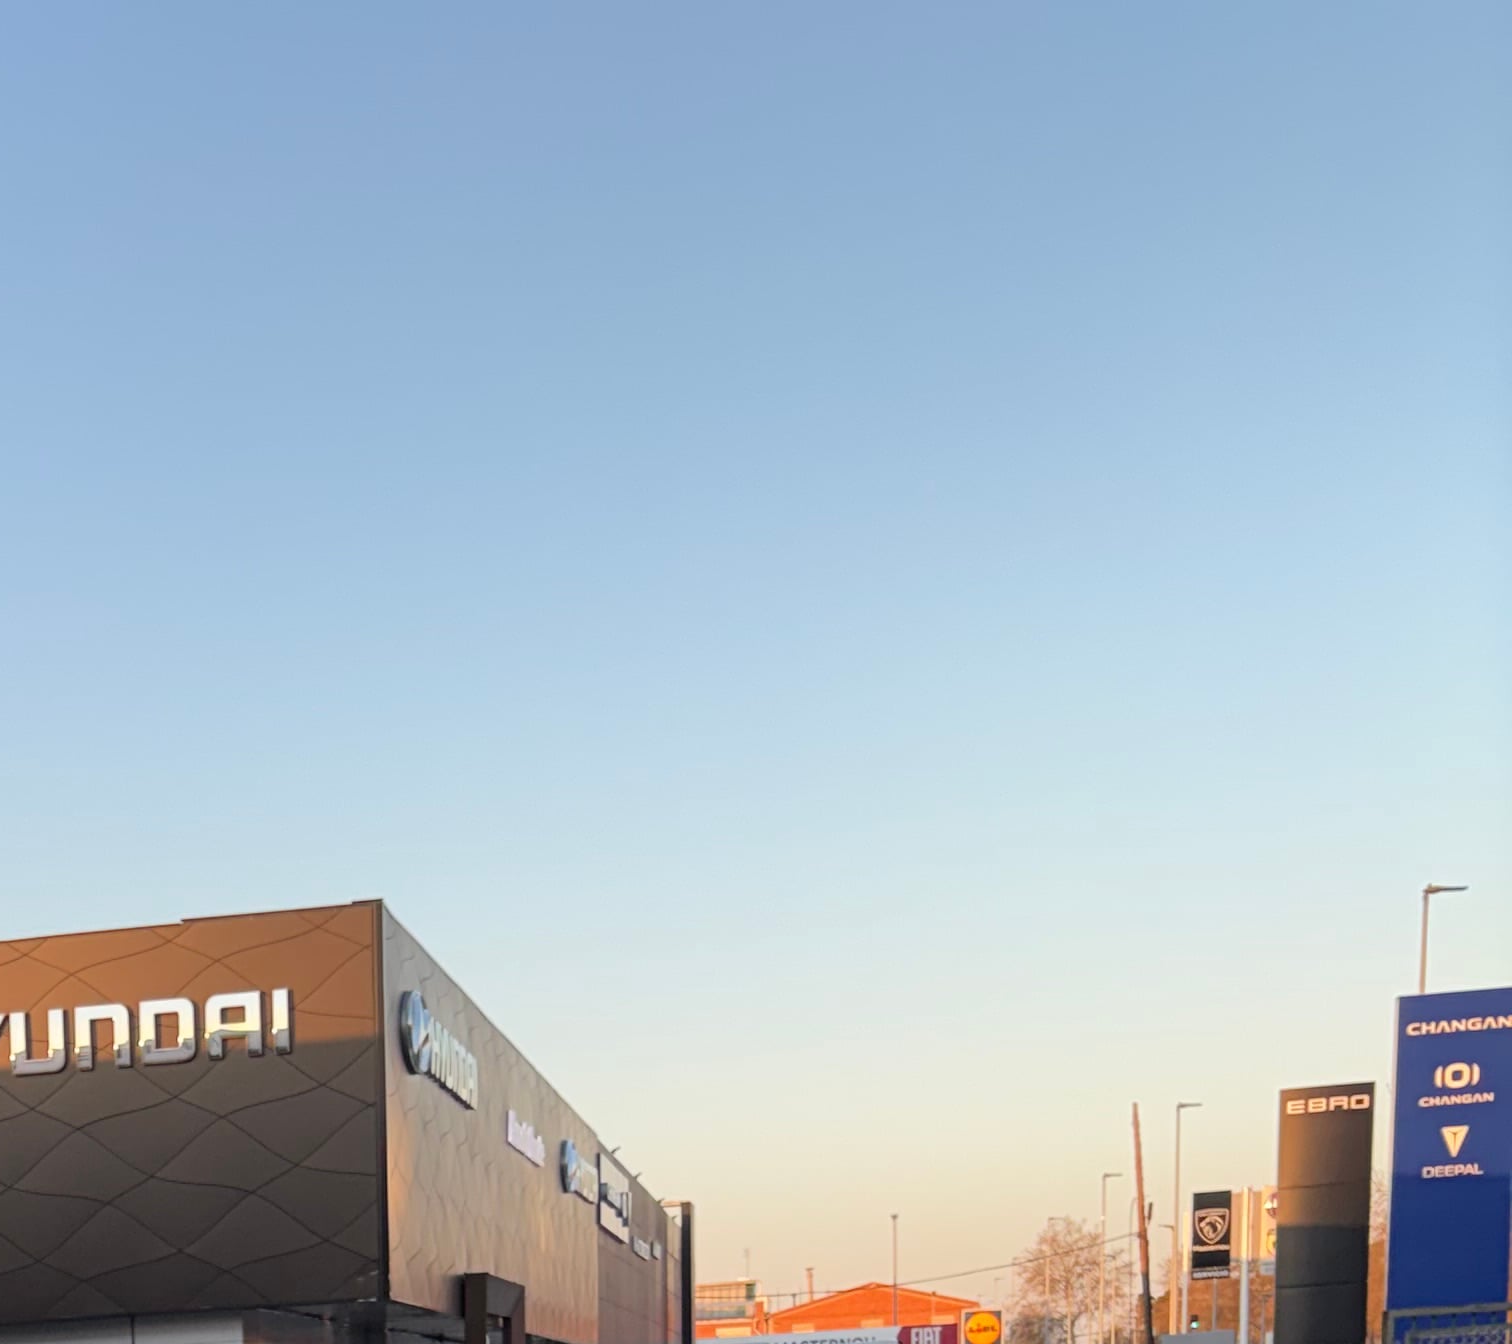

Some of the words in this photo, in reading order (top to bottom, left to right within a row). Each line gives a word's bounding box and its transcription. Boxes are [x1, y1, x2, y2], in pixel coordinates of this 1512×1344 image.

[1405, 1014, 1512, 1036] CHANGAN
[1285, 1093, 1370, 1115] EBRO
[1417, 1091, 1495, 1108] CHANGAN
[1421, 1163, 1484, 1179] DEEPAL
